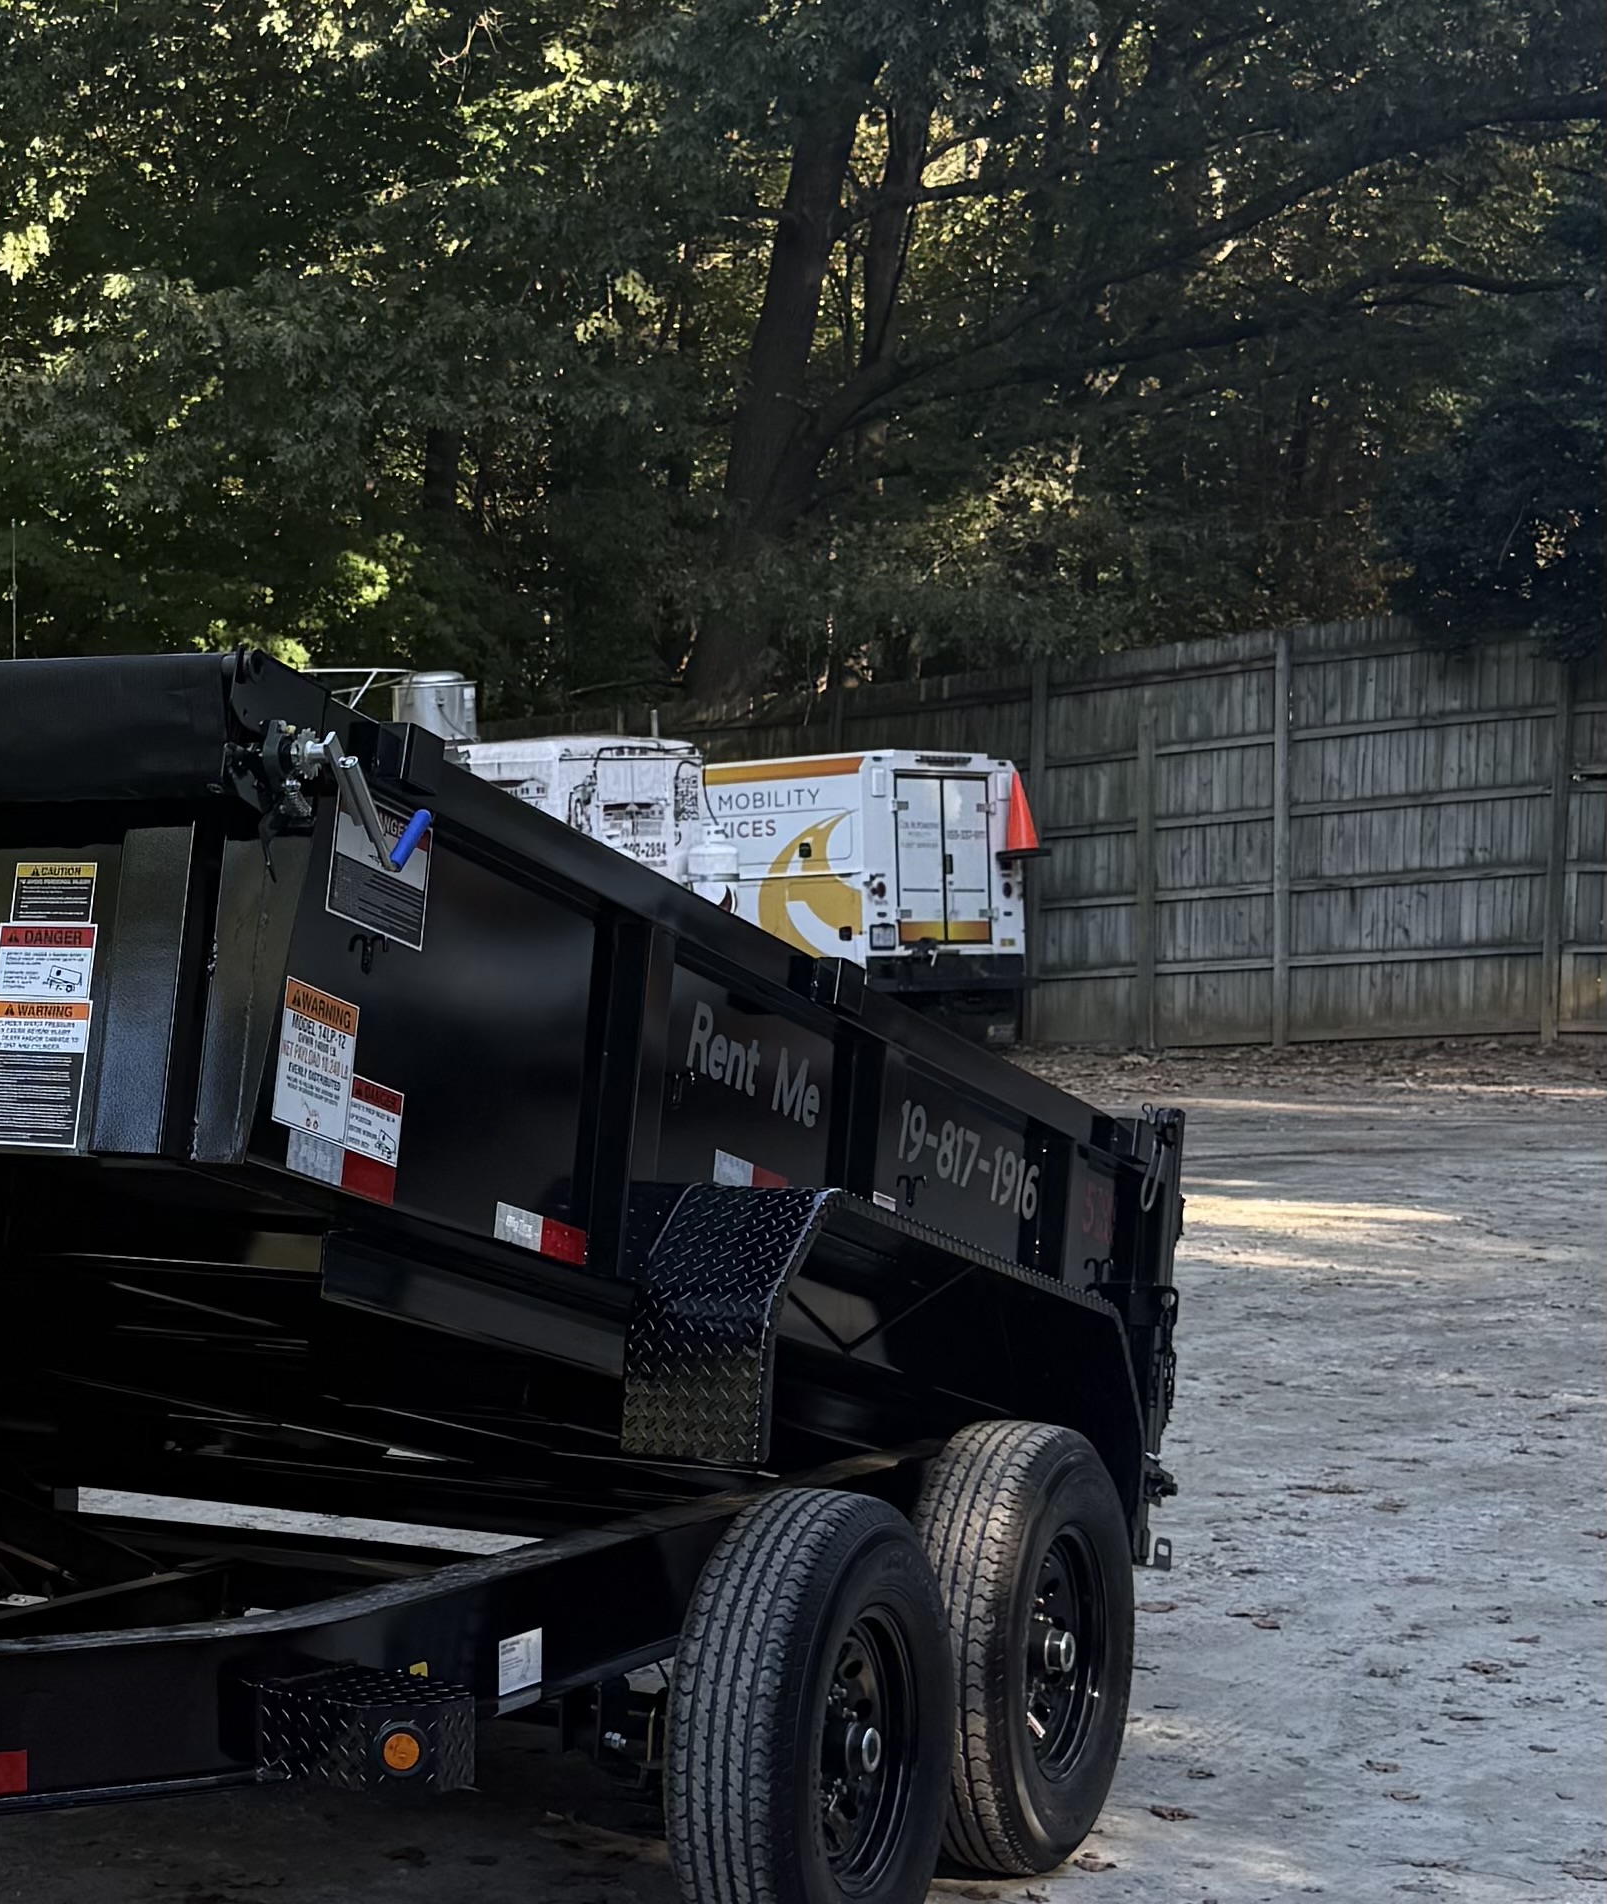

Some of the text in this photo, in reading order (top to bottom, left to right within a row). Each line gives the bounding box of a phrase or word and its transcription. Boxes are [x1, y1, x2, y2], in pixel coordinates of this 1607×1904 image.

[718, 789, 820, 812] MOBILITY
[41, 866, 82, 876] CAUTION
[25, 930, 83, 945] DANGER
[17, 1004, 73, 1018] WARNING
[302, 990, 351, 1030] WARNING
[291, 1013, 316, 1037] MODEL
[686, 1000, 821, 1128] Rent Me
